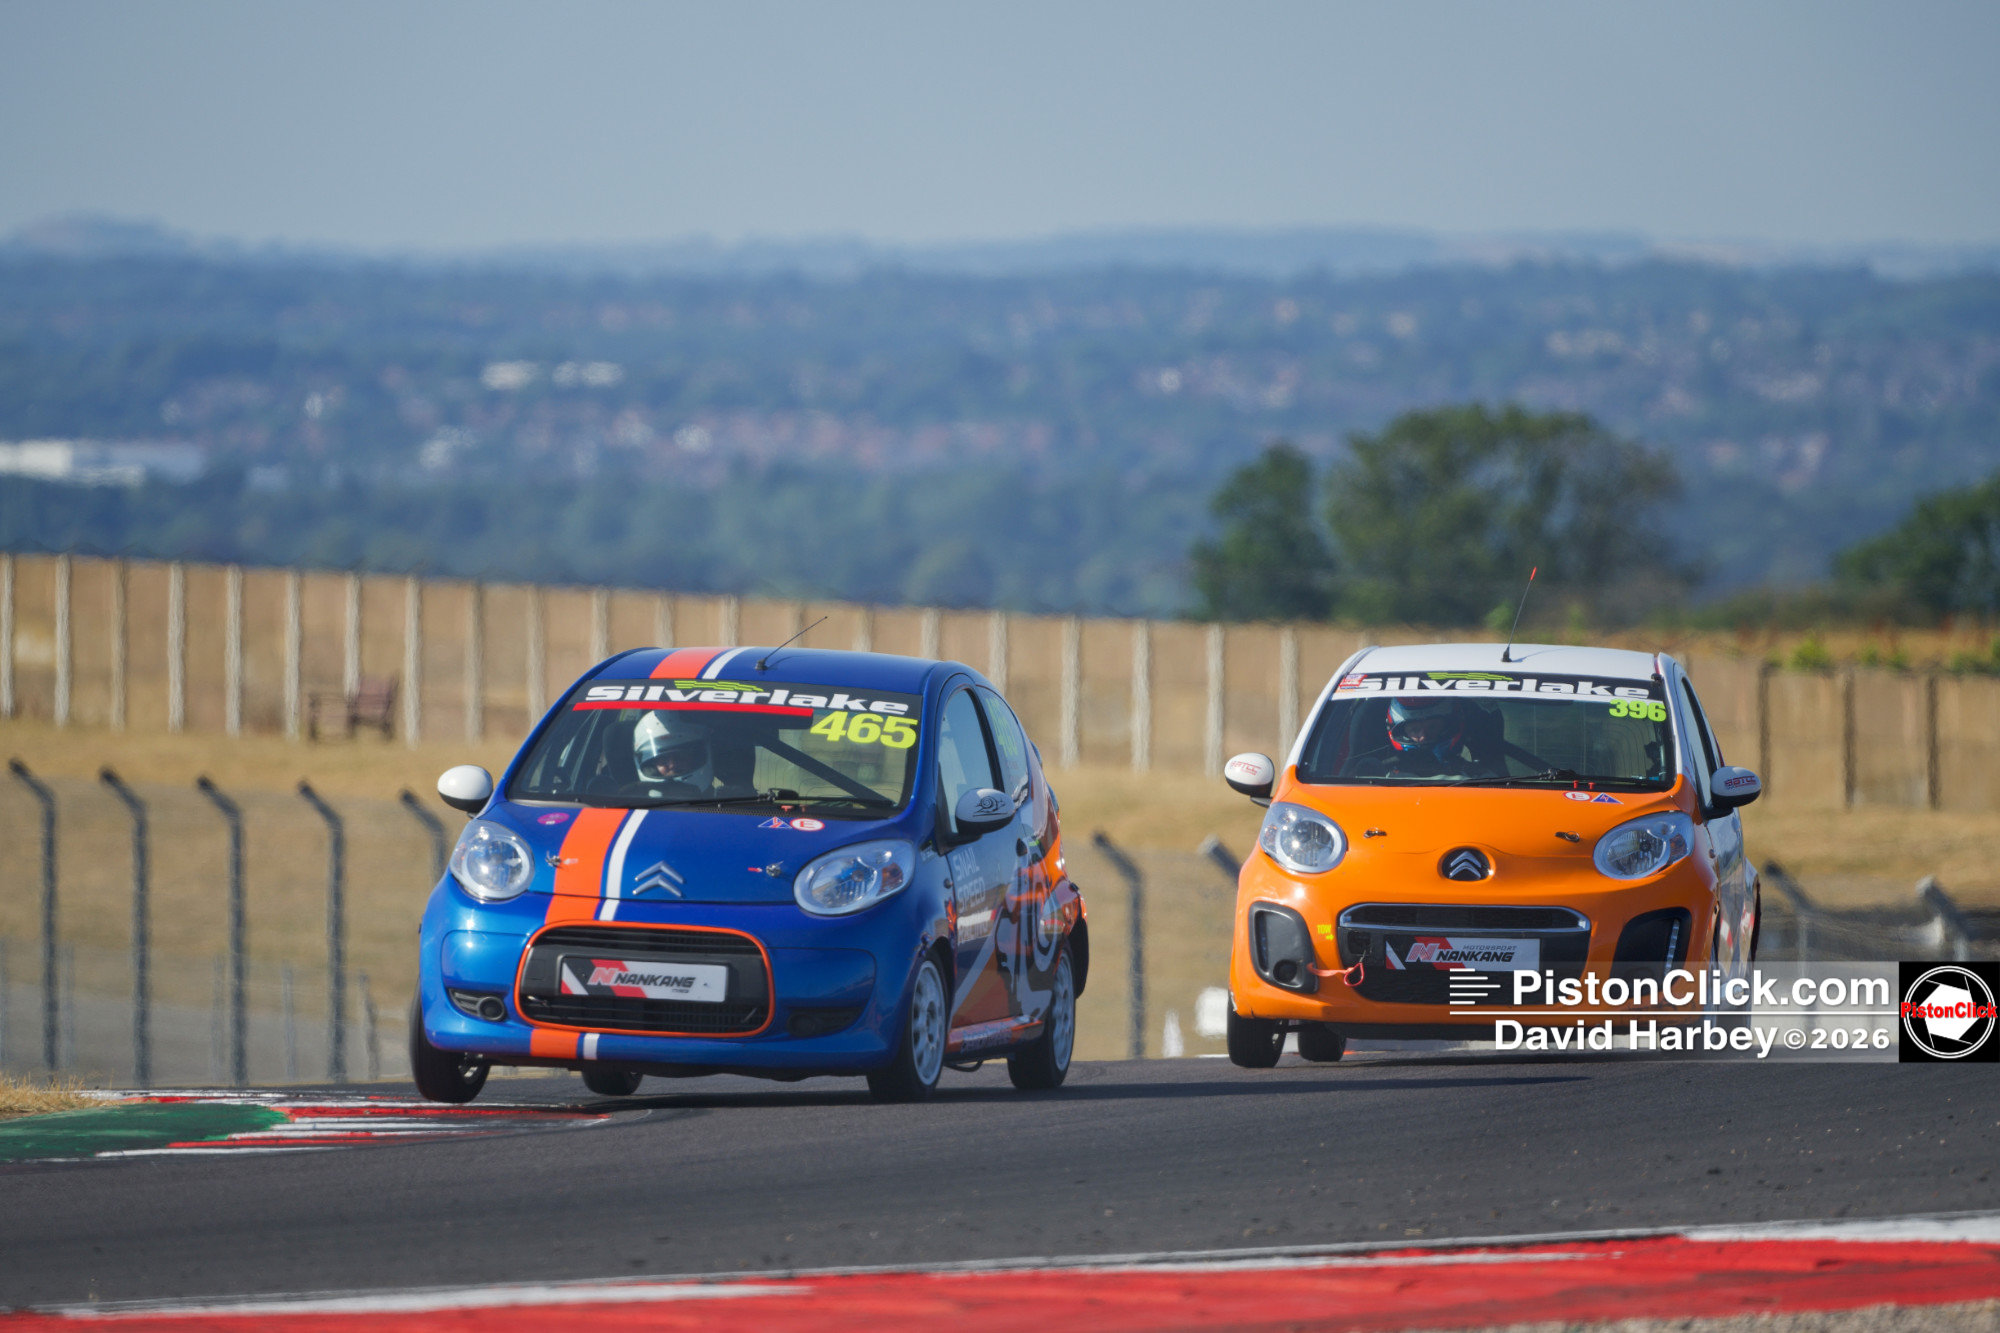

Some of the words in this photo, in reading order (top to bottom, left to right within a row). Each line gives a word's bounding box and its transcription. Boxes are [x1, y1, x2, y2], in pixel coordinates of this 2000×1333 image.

[1345, 677, 1650, 699] Silverlake
[585, 685, 909, 715] Silverlake
[1608, 699, 1667, 721] 396
[810, 711, 919, 749] 465
[957, 877, 987, 914] SPEED
[1436, 950, 1515, 963] NANKANG
[614, 972, 696, 988] NANKANG
